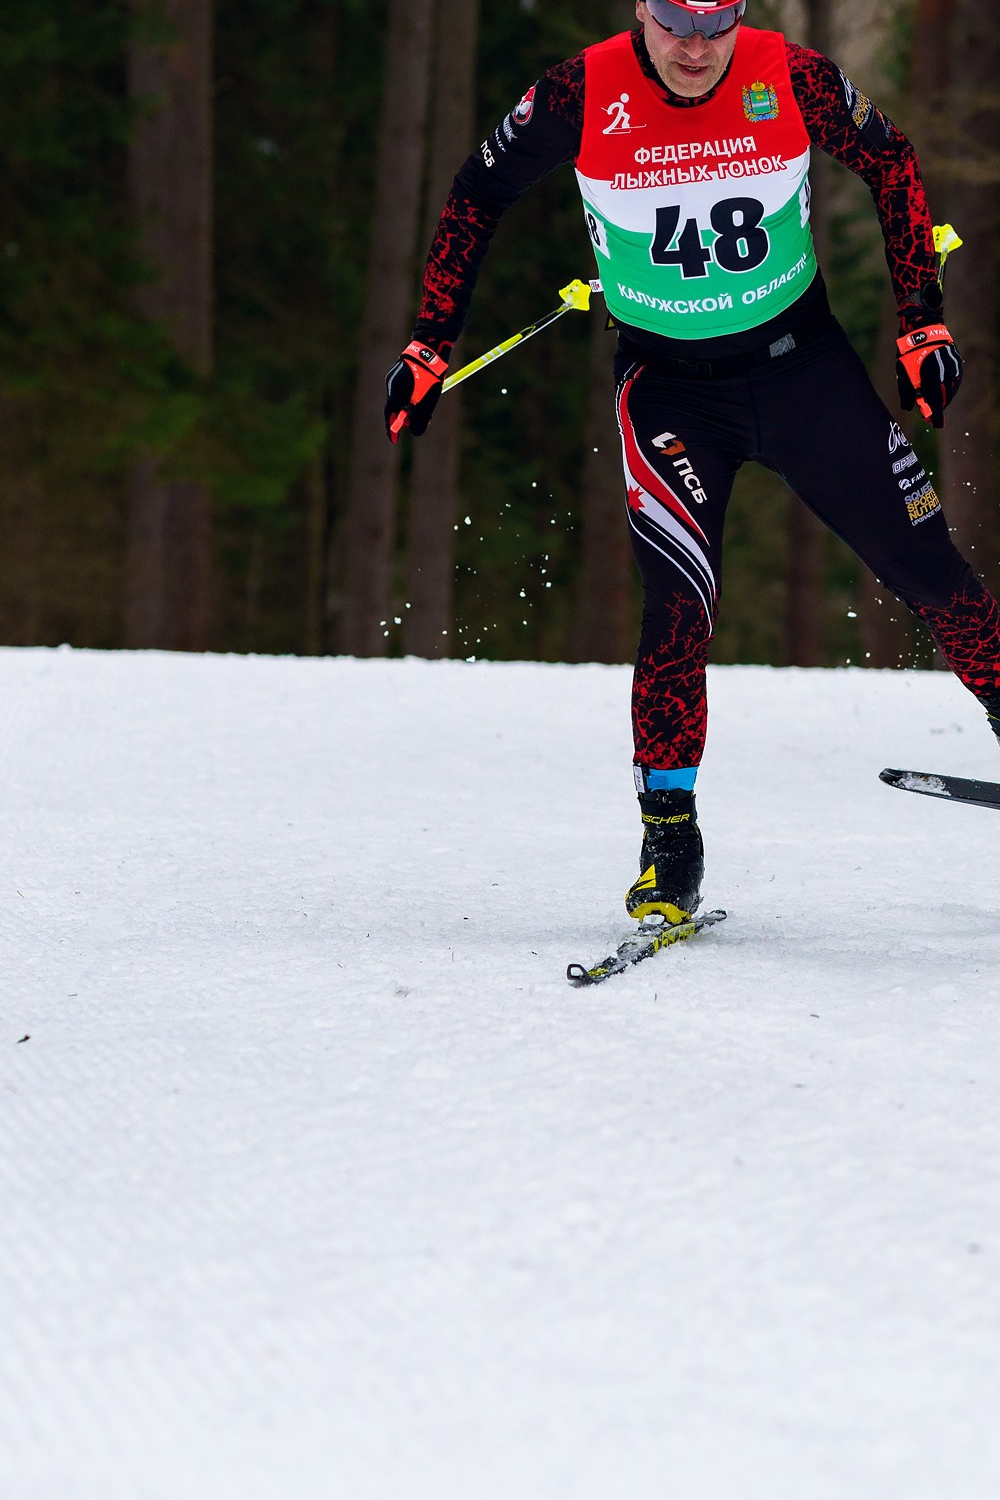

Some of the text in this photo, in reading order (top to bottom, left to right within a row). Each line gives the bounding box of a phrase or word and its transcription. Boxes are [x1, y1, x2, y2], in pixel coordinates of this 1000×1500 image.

[480, 139, 496, 168] ПСБ
[634, 136, 757, 165] ФЕДЕРАЦИЯ
[611, 154, 788, 189] ЛЫЖНЫХ ГОНОК
[584, 211, 601, 247] 8
[650, 196, 770, 280] 48
[617, 283, 733, 314] КАЛУЖСКОЙ
[672, 457, 708, 504] ПСБ
